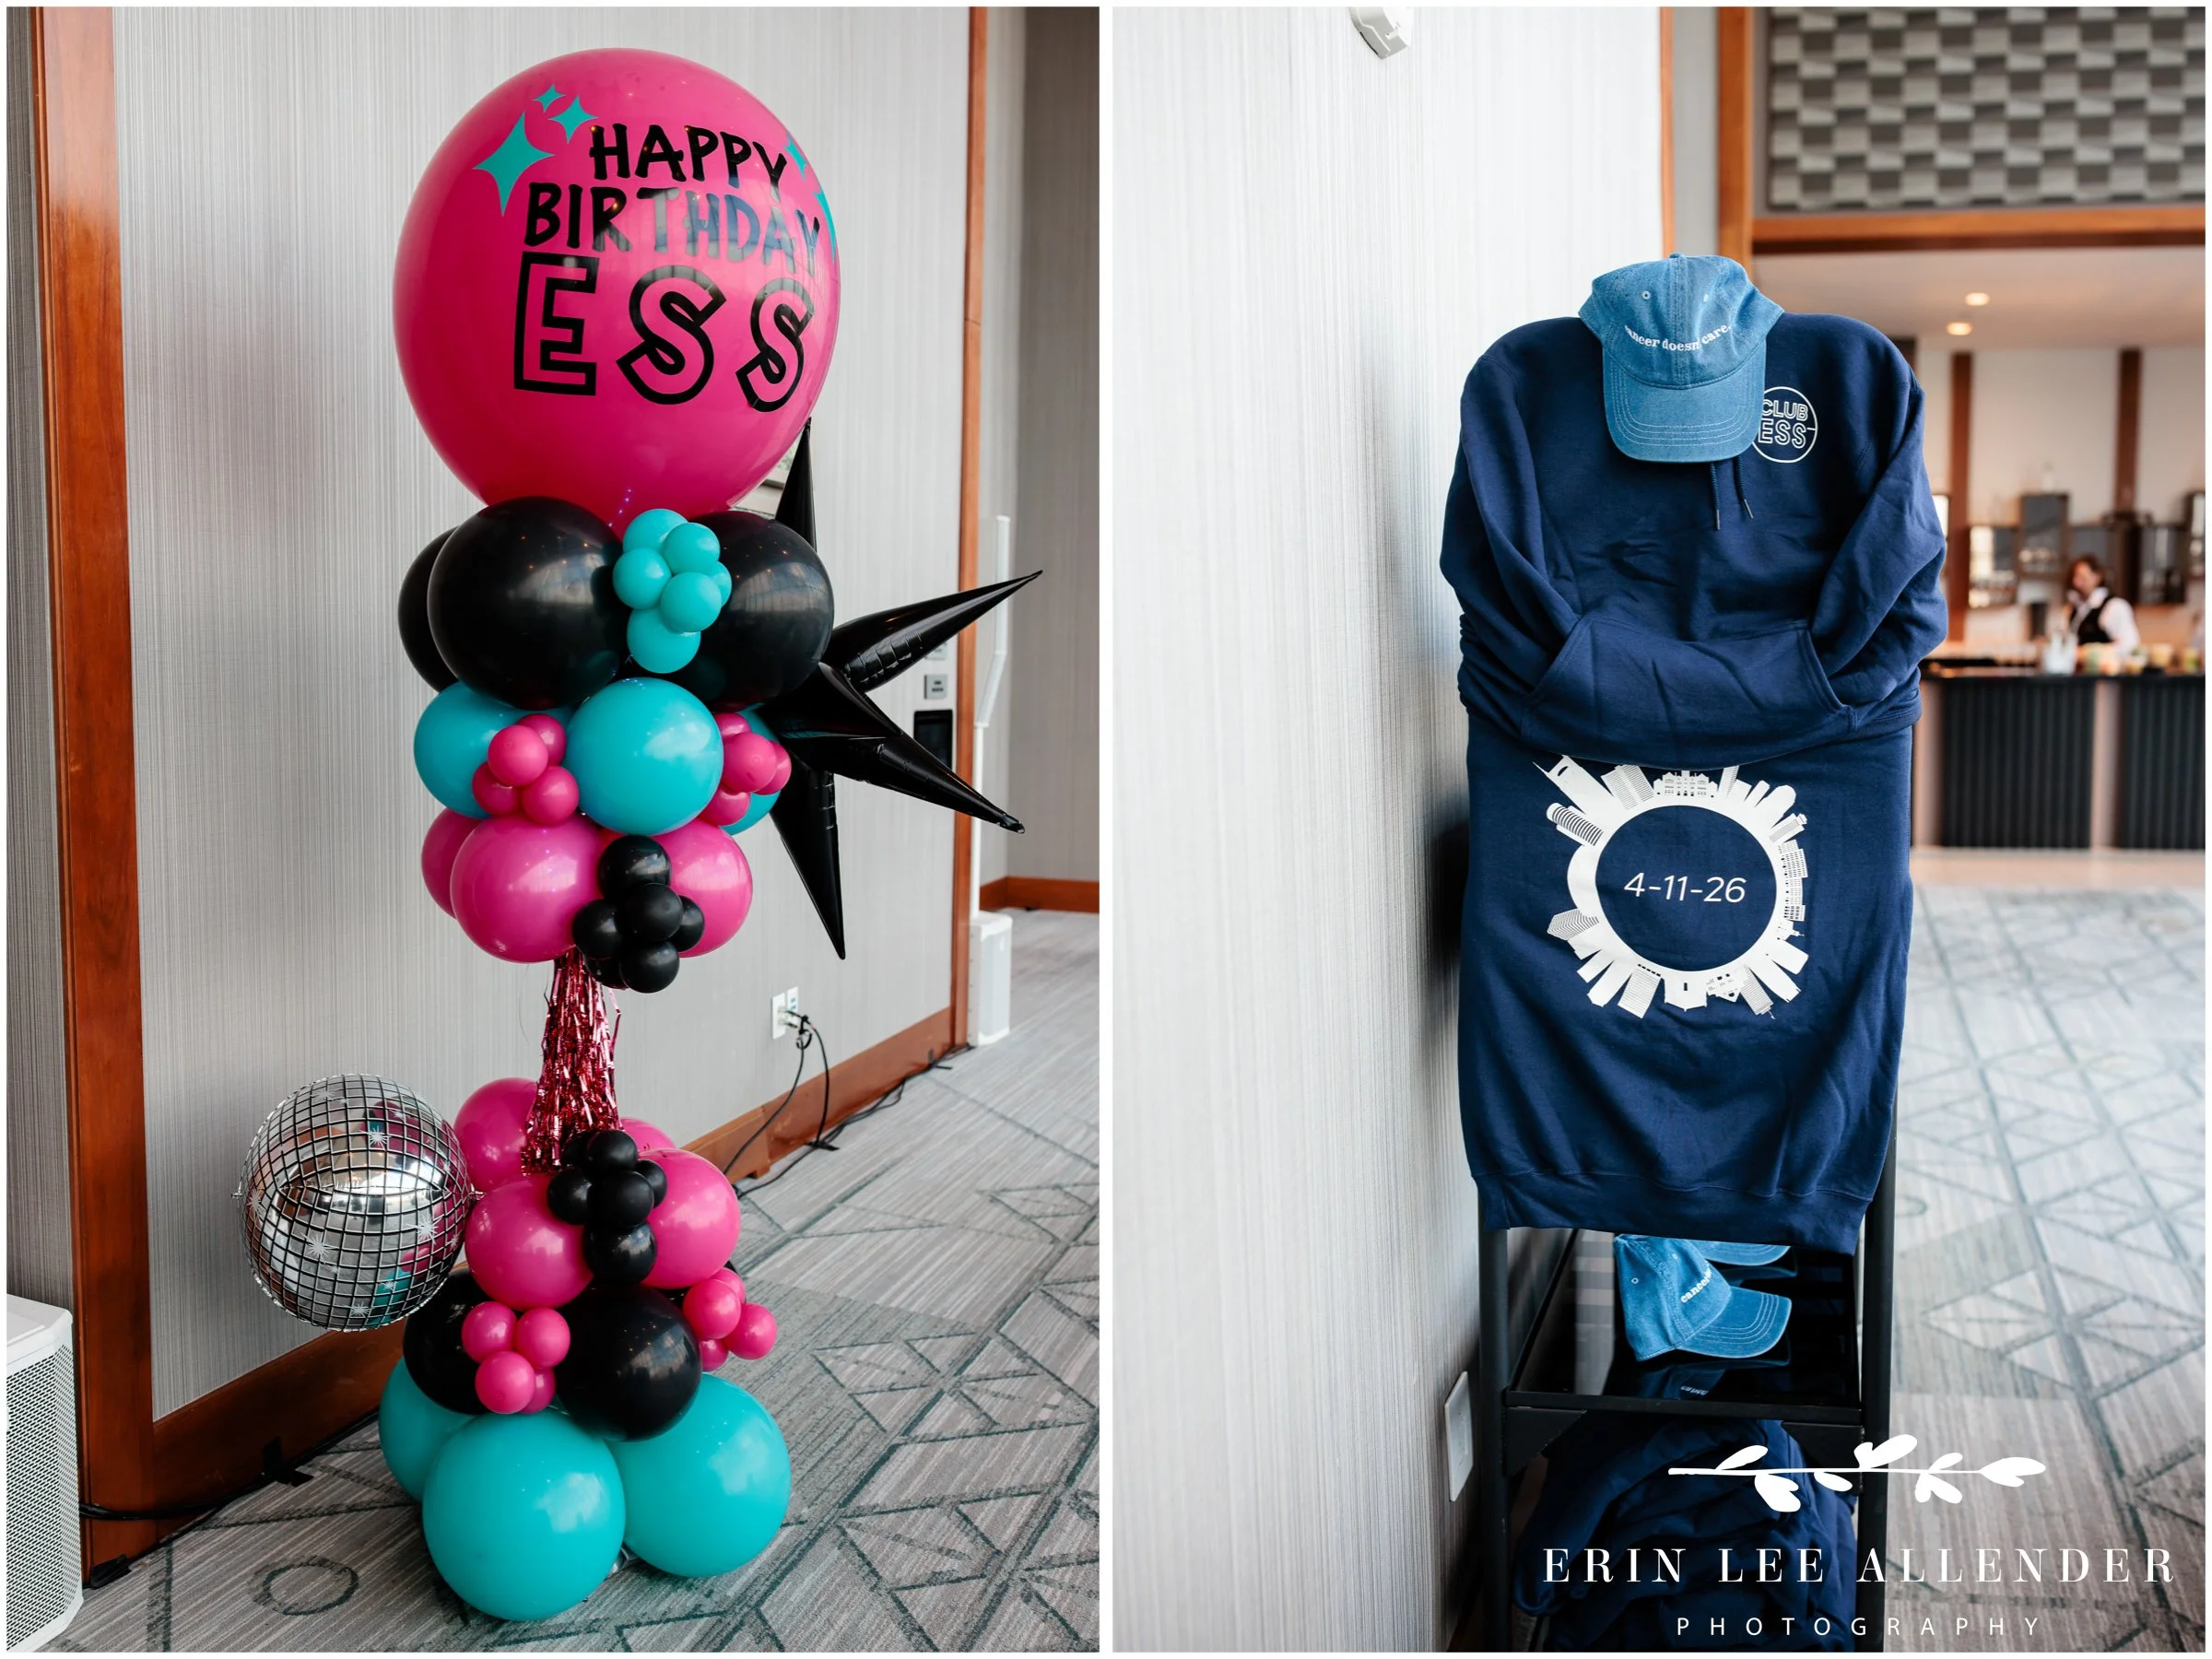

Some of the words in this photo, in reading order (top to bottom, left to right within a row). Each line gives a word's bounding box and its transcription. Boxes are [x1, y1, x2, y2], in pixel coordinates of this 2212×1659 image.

[589, 123, 788, 203] HAPPY
[524, 182, 820, 277] BIRTHDAY
[512, 251, 815, 413] ESS
[1758, 418, 1807, 449] ESS
[1761, 398, 1808, 421] CLUB
[1623, 872, 1747, 903] 4-11-26
